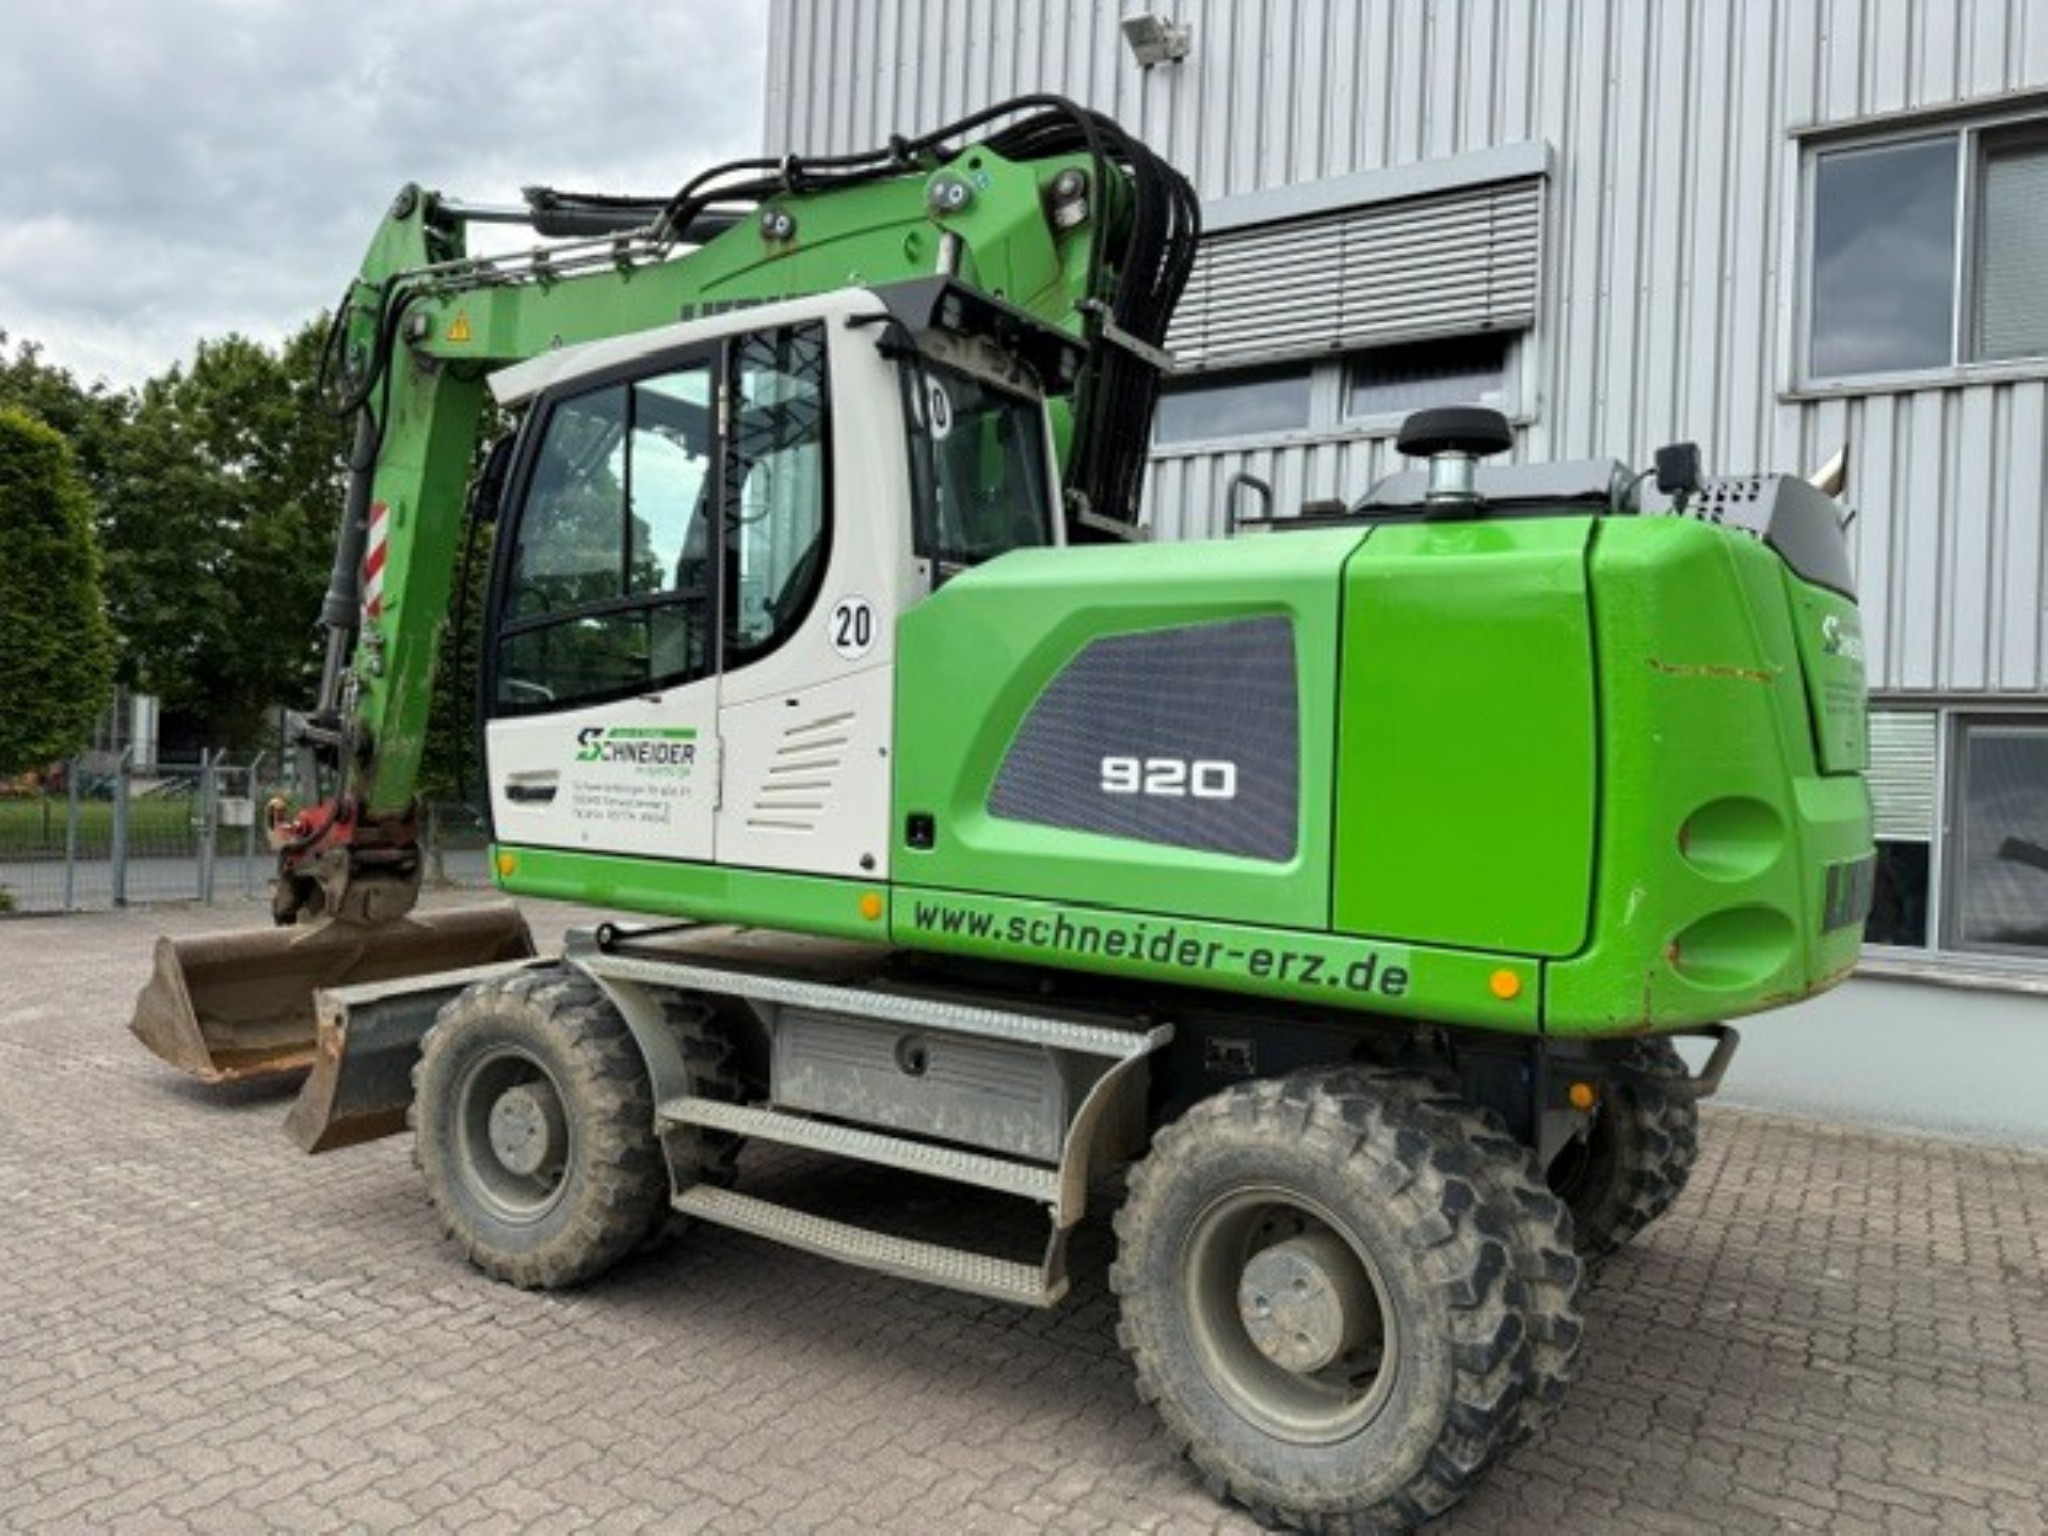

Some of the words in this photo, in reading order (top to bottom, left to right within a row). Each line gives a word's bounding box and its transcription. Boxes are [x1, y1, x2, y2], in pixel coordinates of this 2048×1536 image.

[836, 605, 871, 646] 20
[575, 727, 695, 765] SCHNEIDER
[1101, 756, 1236, 797] 920
[914, 900, 1409, 997] www.schneider-erz.de
